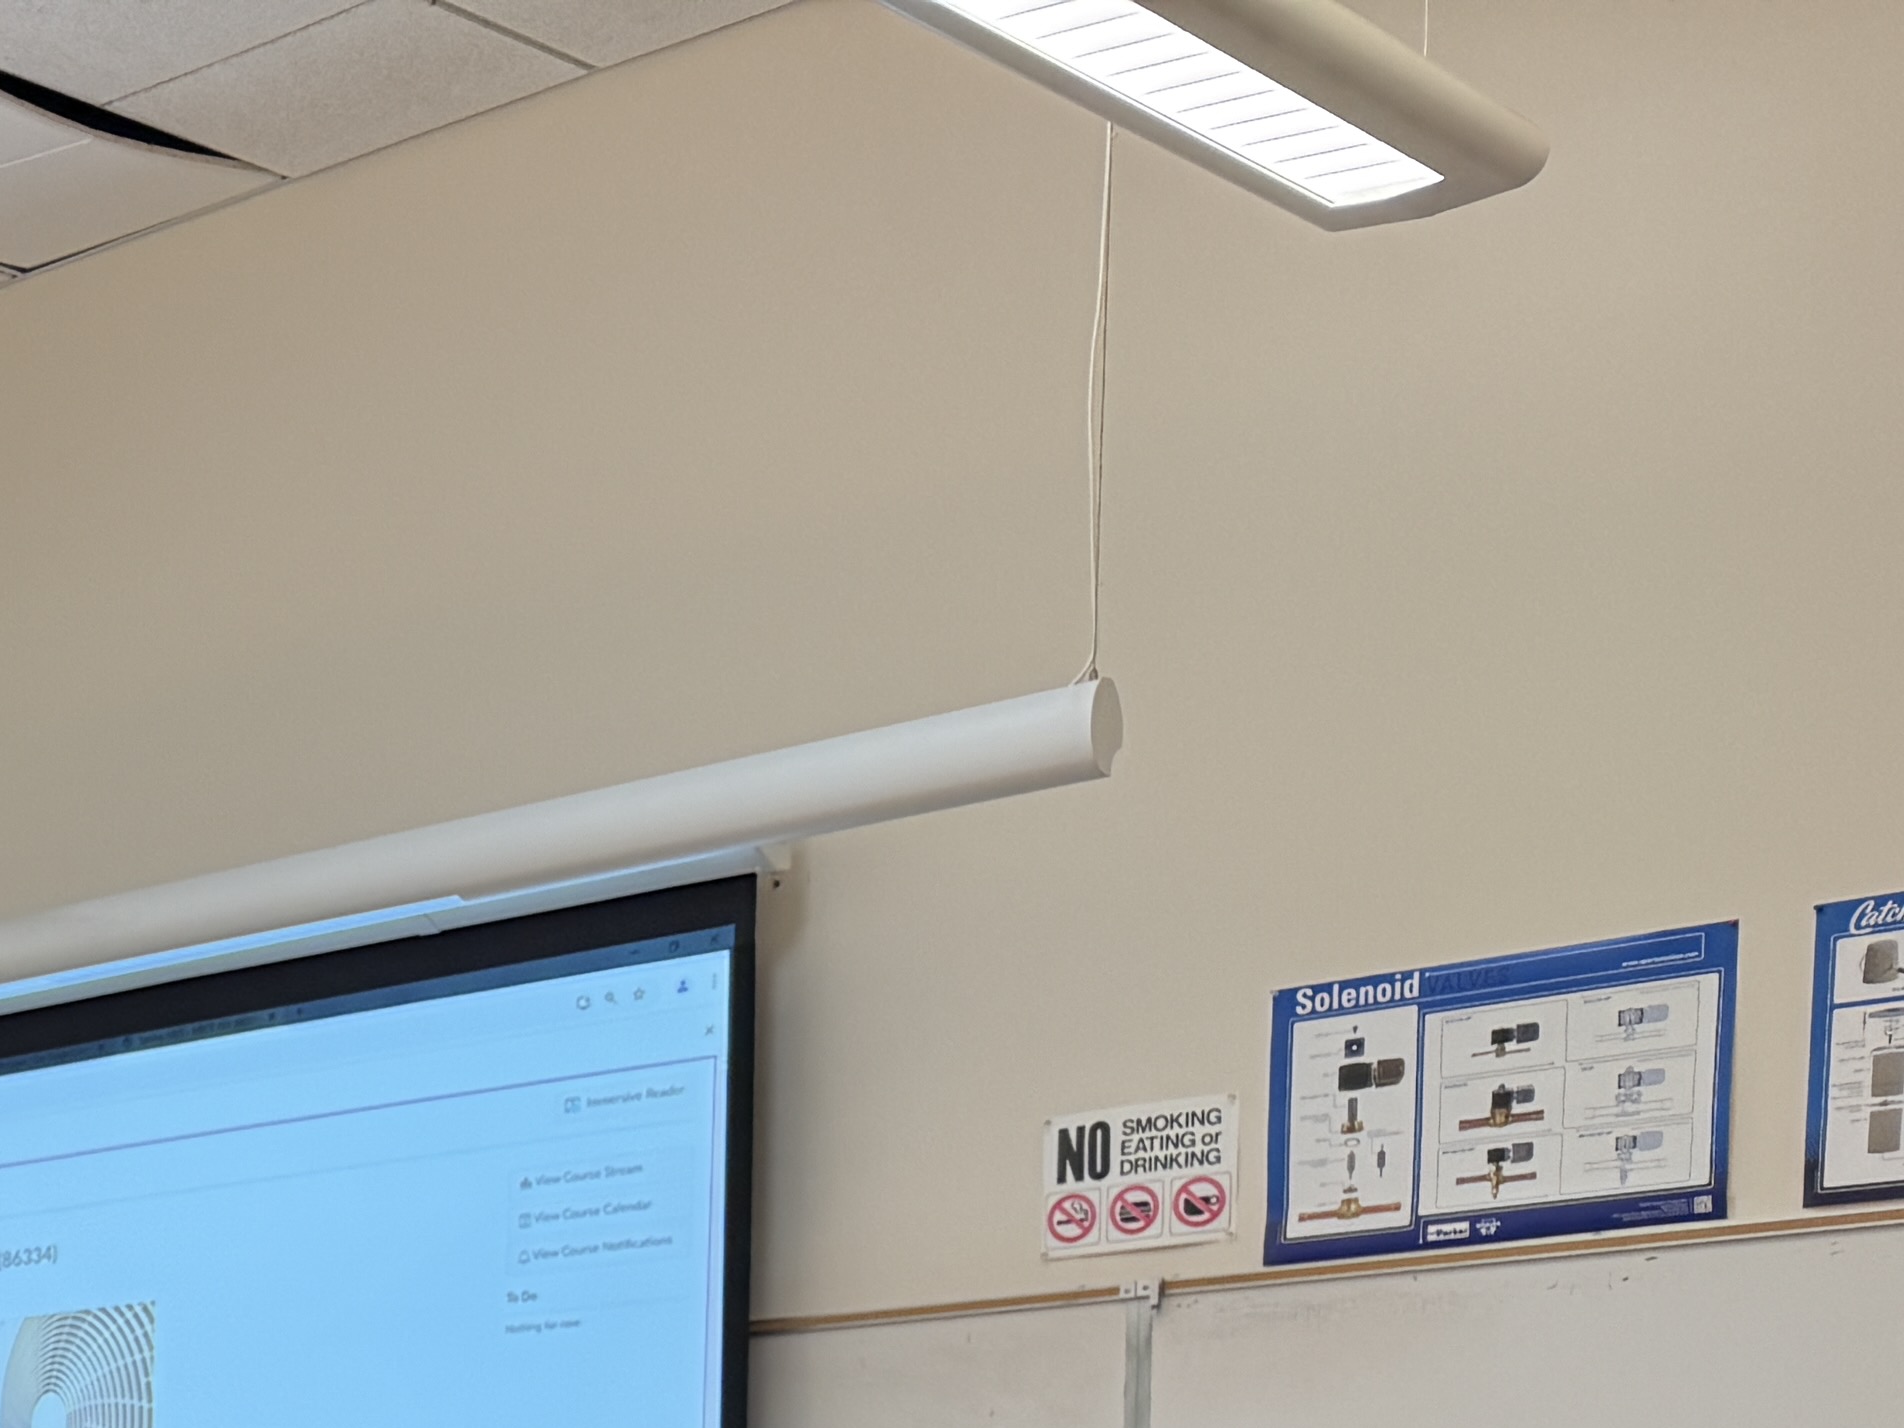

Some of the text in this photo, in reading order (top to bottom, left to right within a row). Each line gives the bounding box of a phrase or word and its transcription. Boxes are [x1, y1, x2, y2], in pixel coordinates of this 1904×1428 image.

[1295, 966, 1511, 1016] Solenoid VALVES
[1122, 1108, 1222, 1137] SMOKING
[1057, 1121, 1111, 1184] NO
[1121, 1131, 1222, 1156] EATING or
[1120, 1148, 1221, 1176] DRINKING
[536, 1175, 561, 1186] View
[563, 1170, 601, 1184] Course
[535, 1211, 560, 1223] View
[563, 1207, 600, 1220] Course
[532, 1248, 559, 1260] View
[561, 1244, 598, 1257] Course
